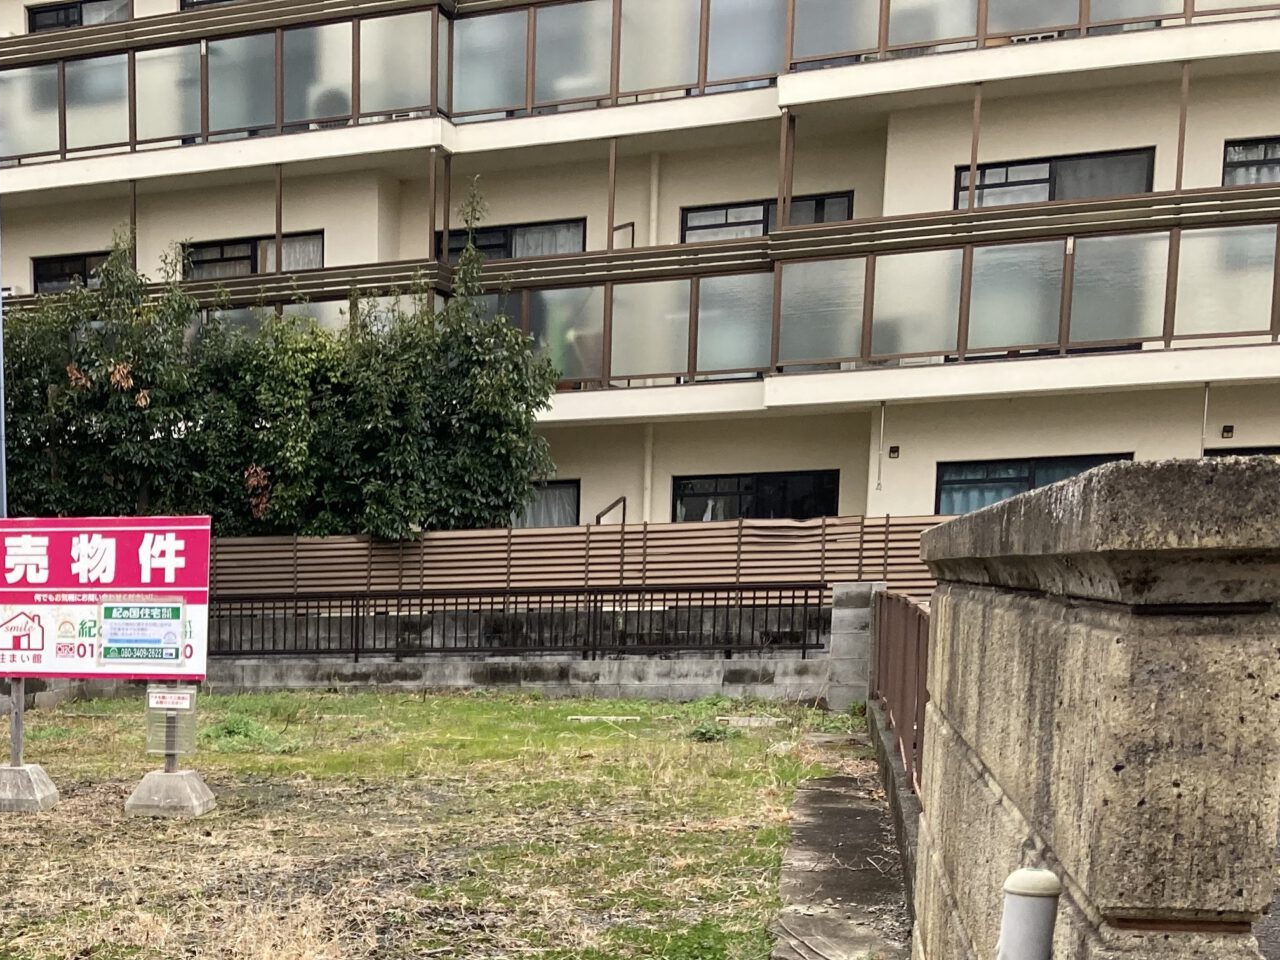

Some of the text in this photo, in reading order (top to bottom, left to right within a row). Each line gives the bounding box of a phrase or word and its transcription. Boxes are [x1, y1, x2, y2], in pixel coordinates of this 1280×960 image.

[4, 532, 186, 584] 売物件
[4, 620, 35, 632] smile
